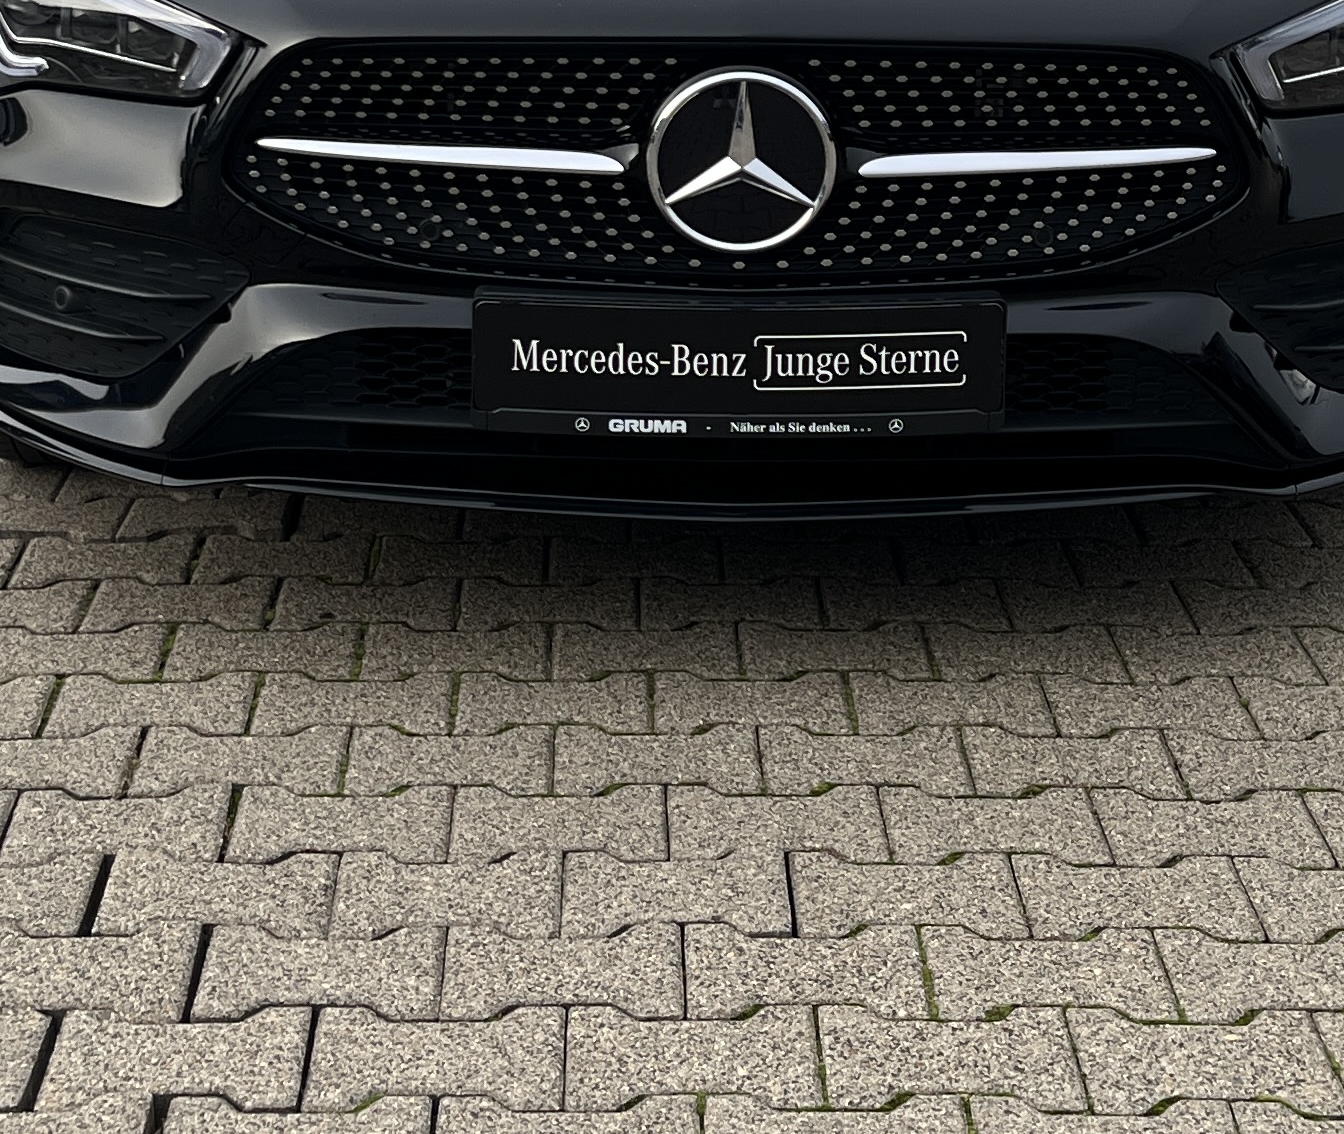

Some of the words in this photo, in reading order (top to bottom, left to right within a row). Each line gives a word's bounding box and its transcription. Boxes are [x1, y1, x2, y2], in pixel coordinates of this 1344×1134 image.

[511, 338, 747, 377] Mercedes-Benz
[761, 344, 850, 384] Junge
[859, 343, 959, 376] Sterne
[608, 418, 687, 434] GRUMA
[730, 421, 765, 433] Näher
[769, 421, 785, 433] als
[788, 421, 806, 433] Sie
[809, 421, 851, 433] denken
